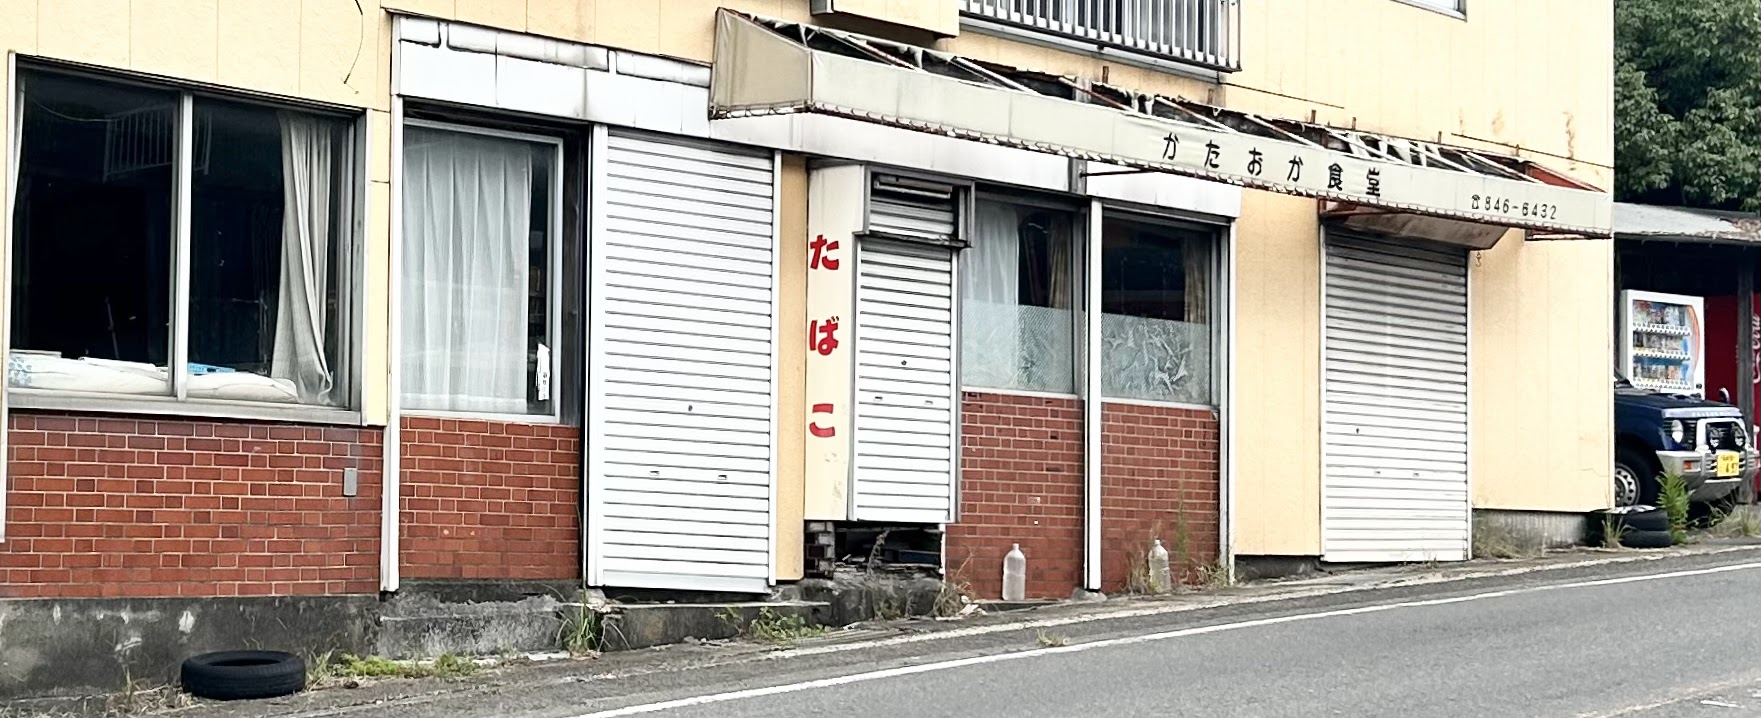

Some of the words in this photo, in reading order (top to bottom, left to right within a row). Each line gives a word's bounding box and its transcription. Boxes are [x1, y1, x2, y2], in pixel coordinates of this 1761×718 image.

[1162, 132, 1381, 197] かたおか食堂
[1485, 196, 1556, 219] 846-6432
[809, 234, 840, 438] たばこ
